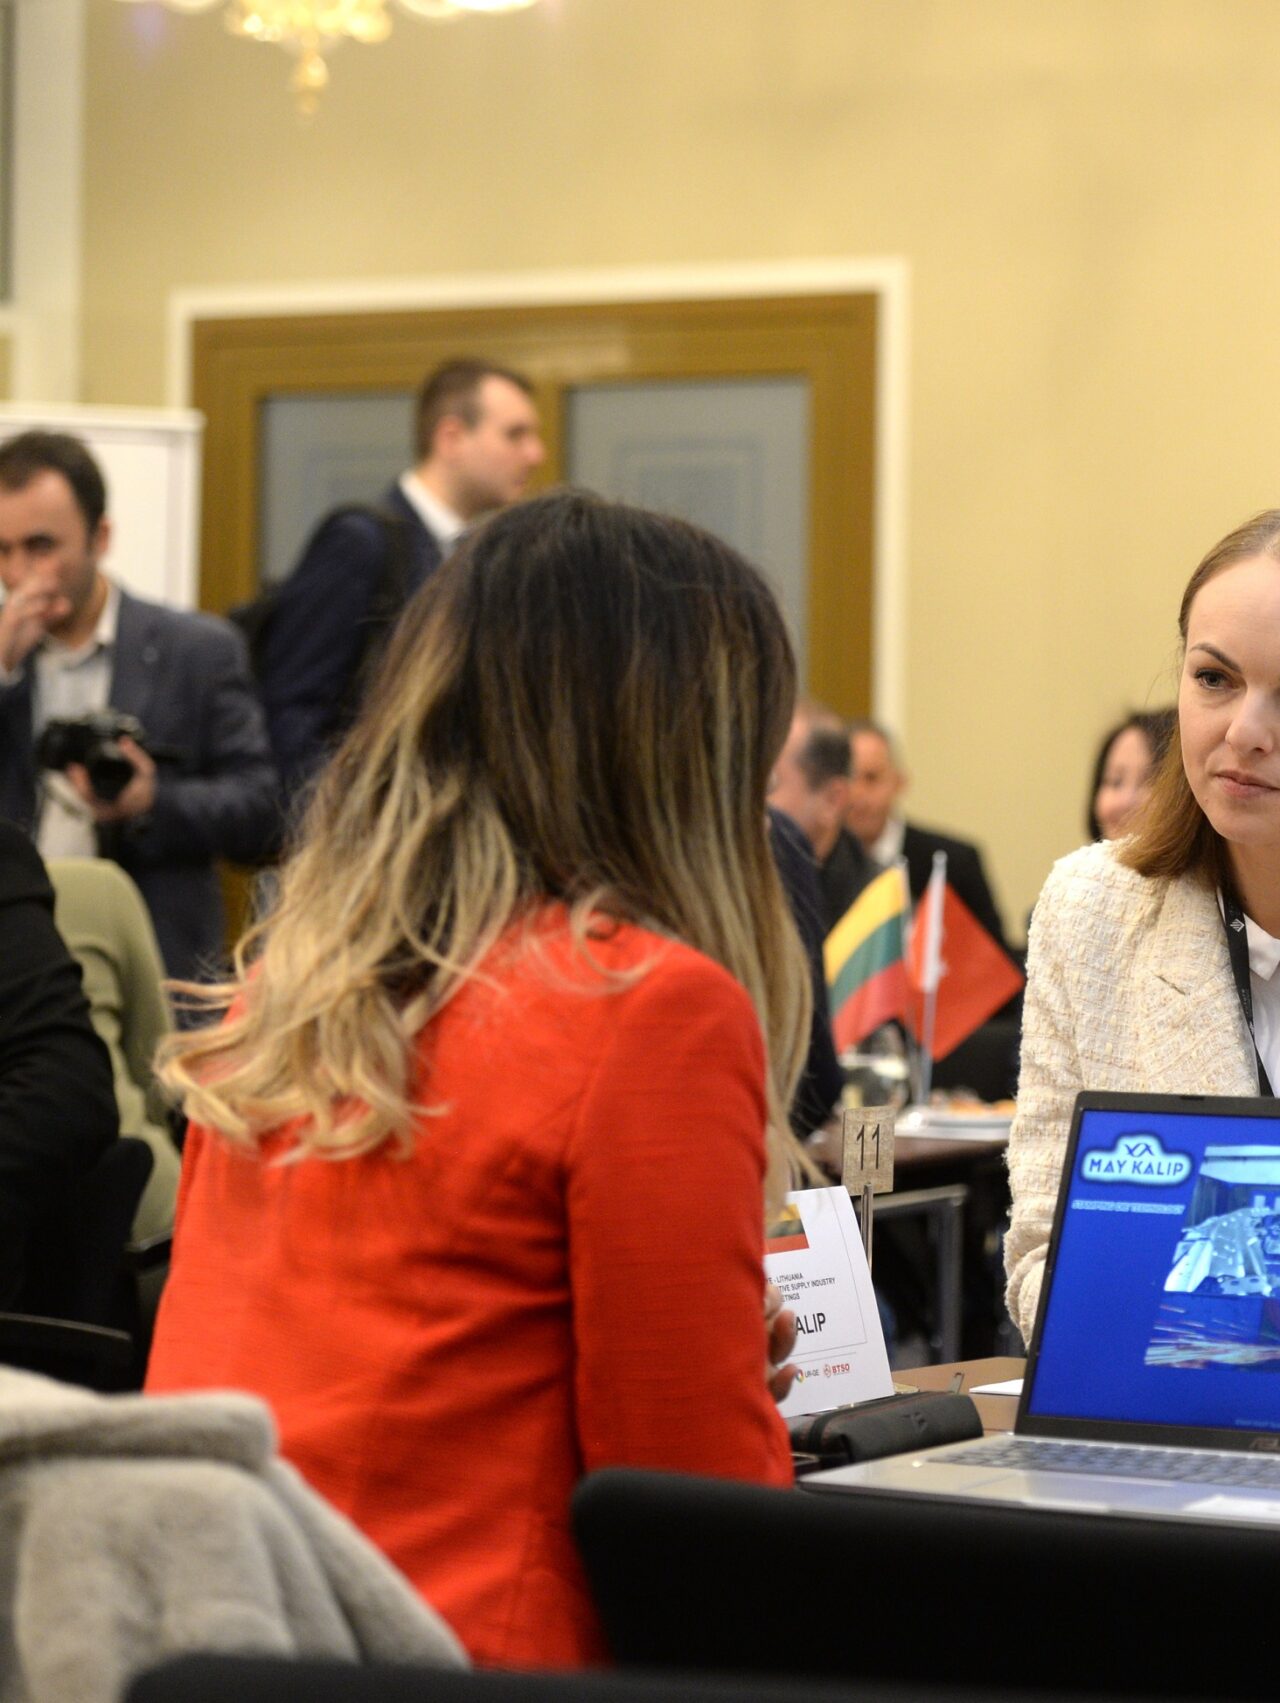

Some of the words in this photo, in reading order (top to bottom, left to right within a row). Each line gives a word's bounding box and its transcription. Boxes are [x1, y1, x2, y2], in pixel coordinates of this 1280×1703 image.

[856, 1123, 880, 1171] 11
[1089, 1158, 1127, 1174] MAY
[1131, 1160, 1184, 1176] KALIP
[776, 1272, 803, 1283] LITHUANIA
[779, 1284, 790, 1292] TIVE
[791, 1281, 810, 1291] SUPPLY
[811, 1277, 835, 1287] INDUSTRY
[795, 1312, 826, 1336] ALIP
[832, 1363, 850, 1373] BTSO
